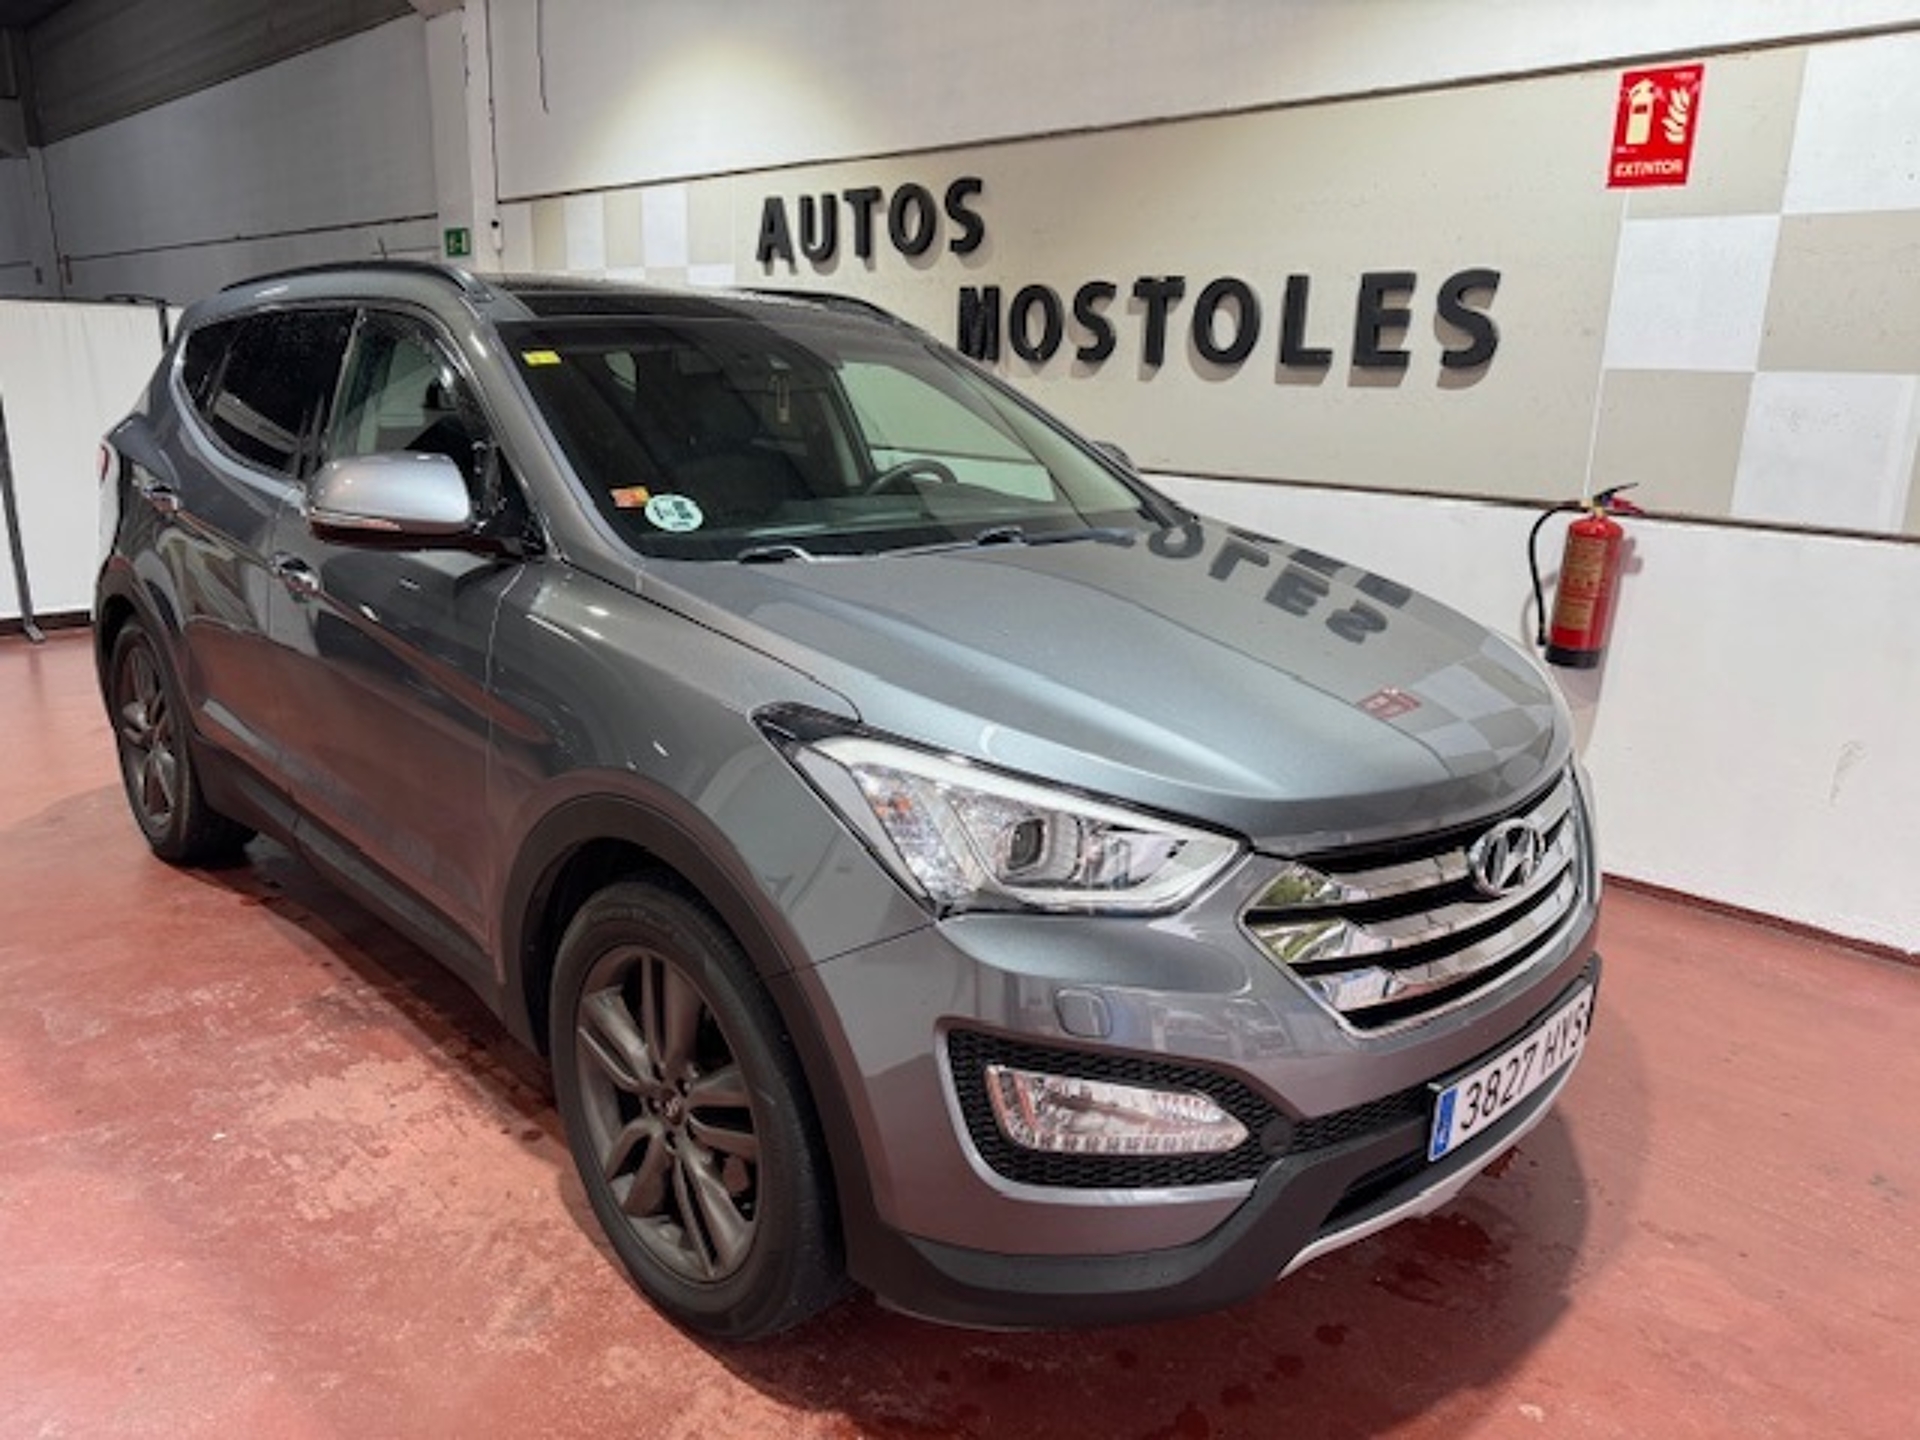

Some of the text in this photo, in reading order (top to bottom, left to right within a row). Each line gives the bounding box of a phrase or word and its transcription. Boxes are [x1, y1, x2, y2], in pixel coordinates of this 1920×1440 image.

[756, 176, 985, 264] AUTOS
[957, 269, 1501, 368] MOSTOLES
[1460, 1001, 1585, 1131] 3827 HYS
